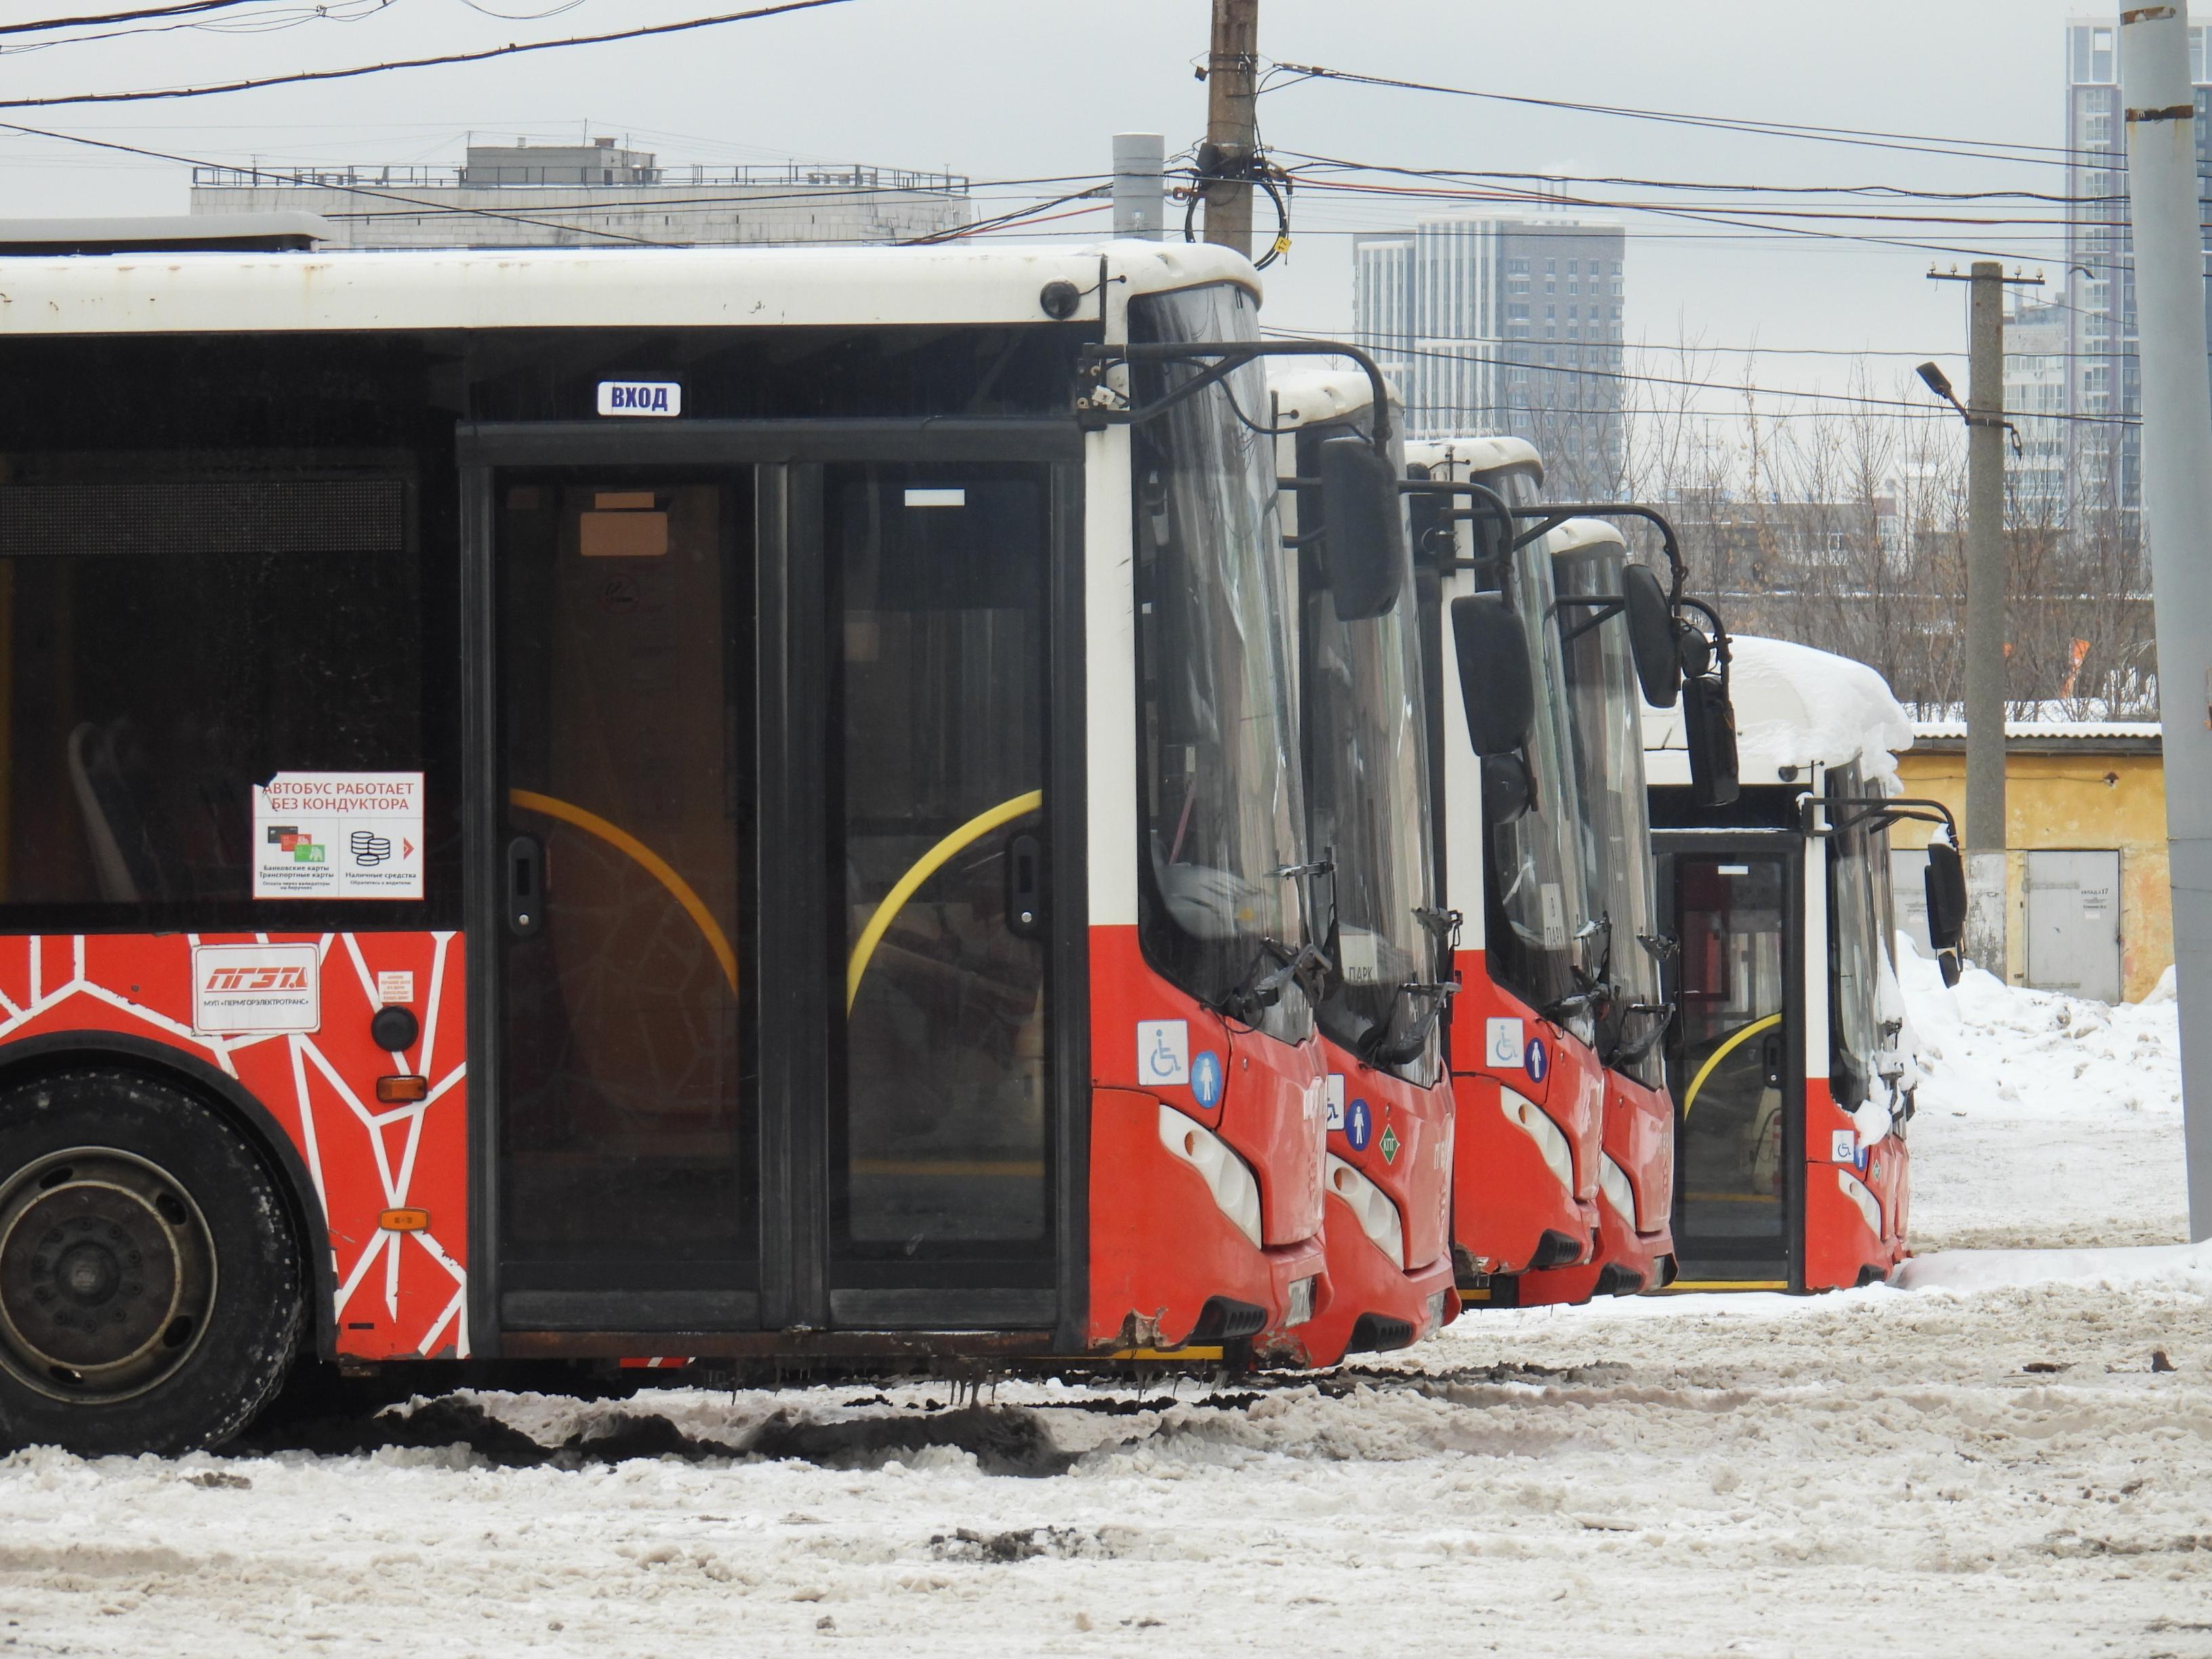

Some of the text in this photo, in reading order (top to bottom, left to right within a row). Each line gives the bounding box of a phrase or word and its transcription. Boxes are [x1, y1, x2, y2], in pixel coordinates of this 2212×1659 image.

[1278, 239, 1286, 250] 17
[611, 387, 668, 411] ВХОД
[262, 783, 414, 795] АВТОБУС РАБОТАЕТ
[272, 798, 409, 813] БЕЗ КОНДУКТОРА
[1349, 966, 1373, 982] ПАРК
[220, 998, 308, 1006] «ПЕРМГОРЭЛЕКТРОТРАНС»
[1383, 1138, 1395, 1151] КПГ
